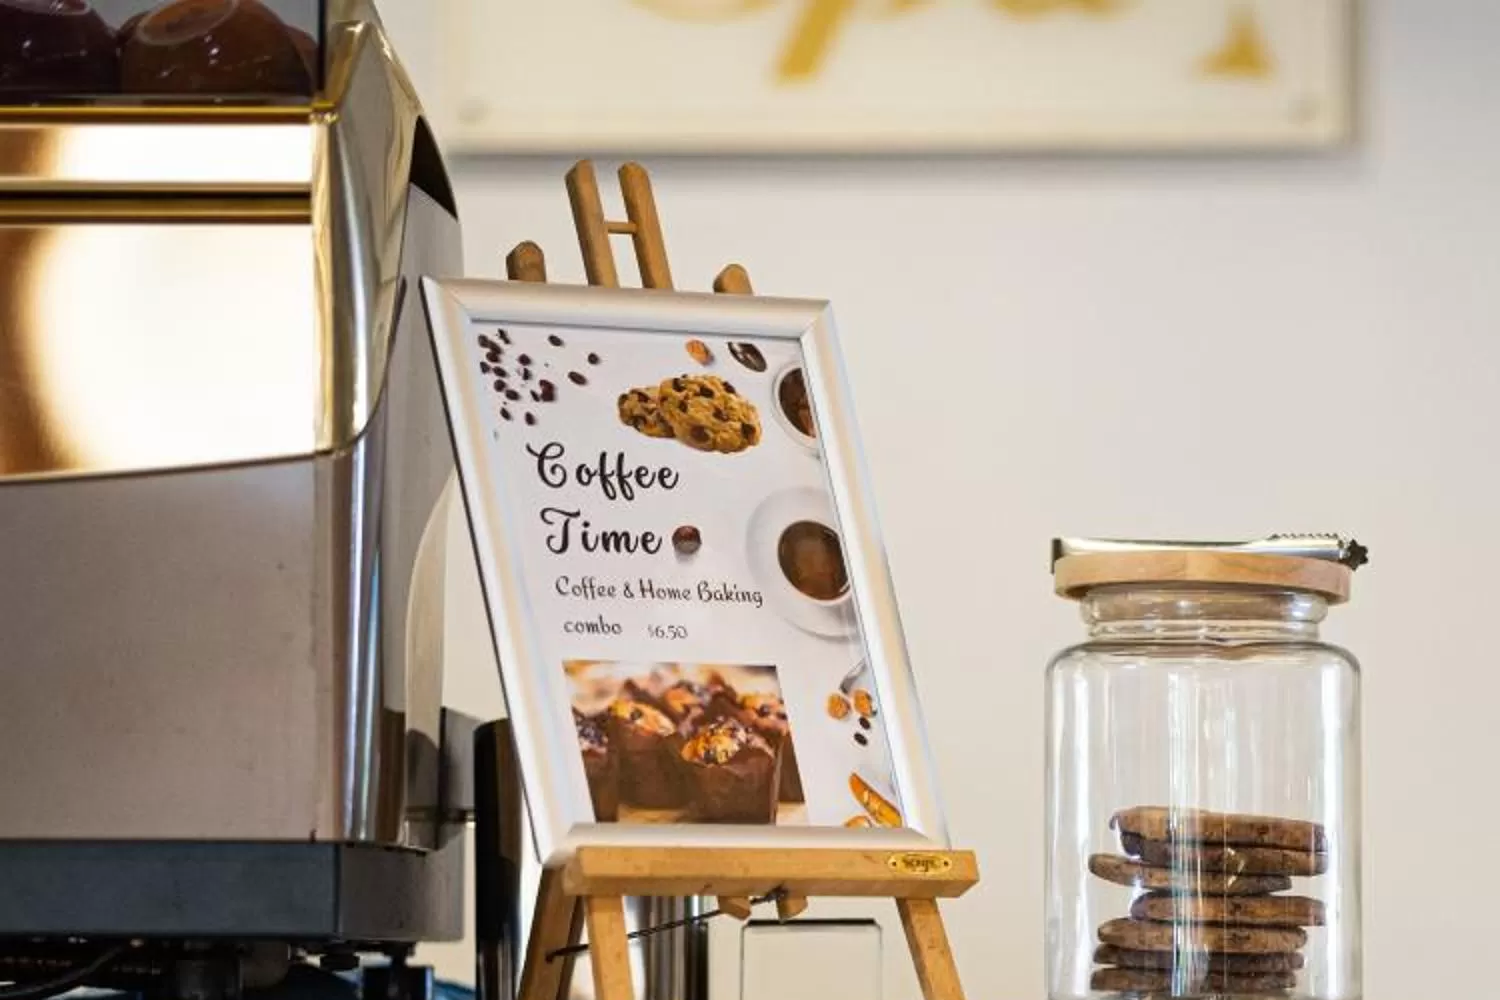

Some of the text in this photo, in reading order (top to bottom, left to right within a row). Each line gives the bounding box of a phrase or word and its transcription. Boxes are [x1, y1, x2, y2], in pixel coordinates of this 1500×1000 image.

[525, 442, 680, 501] Coffee
[540, 507, 663, 555] Time
[555, 575, 764, 608] Coffee & Home Baking
[563, 614, 623, 635] combo
